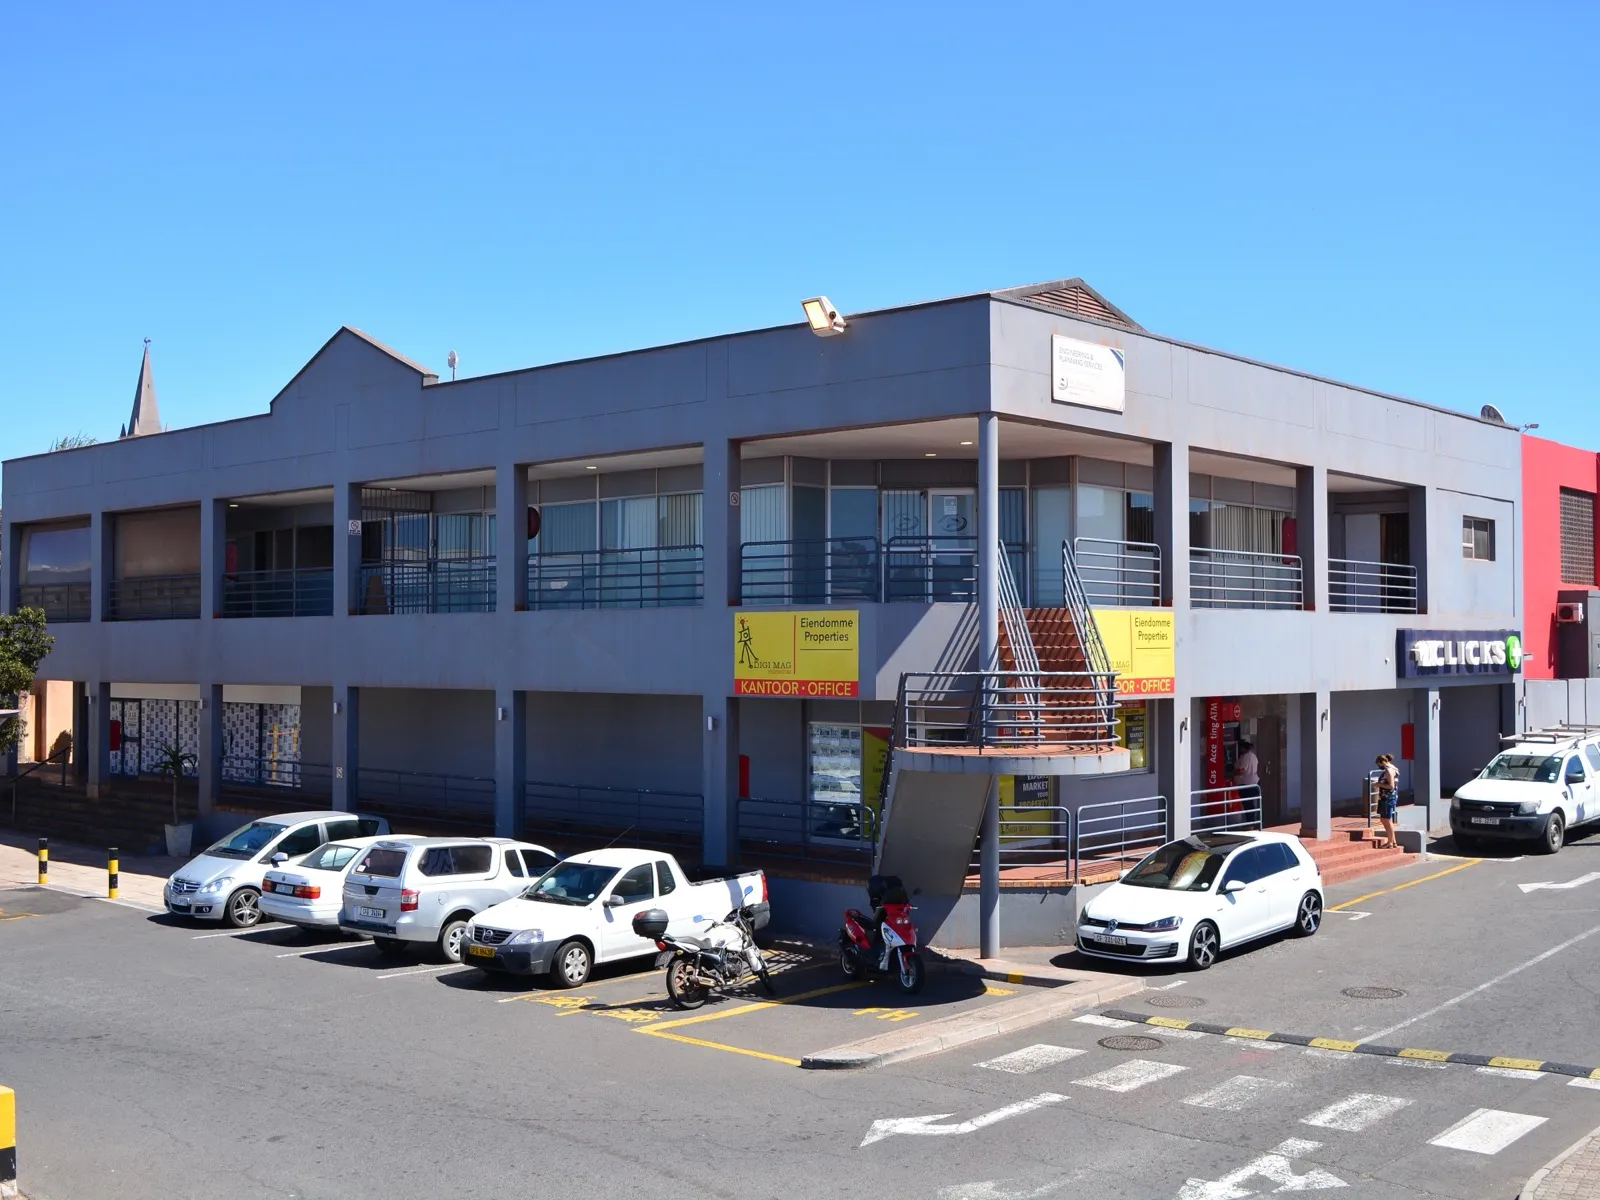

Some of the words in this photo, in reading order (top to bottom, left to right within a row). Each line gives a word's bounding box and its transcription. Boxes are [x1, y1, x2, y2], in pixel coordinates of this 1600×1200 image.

[800, 617, 854, 628] Eiendomme
[1134, 617, 1171, 628] Eiendomme
[804, 631, 849, 644] Properties
[1138, 630, 1168, 643] Properties
[1427, 640, 1506, 666] CLICKS
[753, 661, 771, 669] DIGI
[773, 661, 792, 669] MAG
[741, 681, 799, 695] KANTOOR
[807, 682, 852, 696] OFFICE
[1140, 679, 1171, 693] OFFICE
[1210, 702, 1218, 721] ATM
[1022, 781, 1049, 792] MARKET
